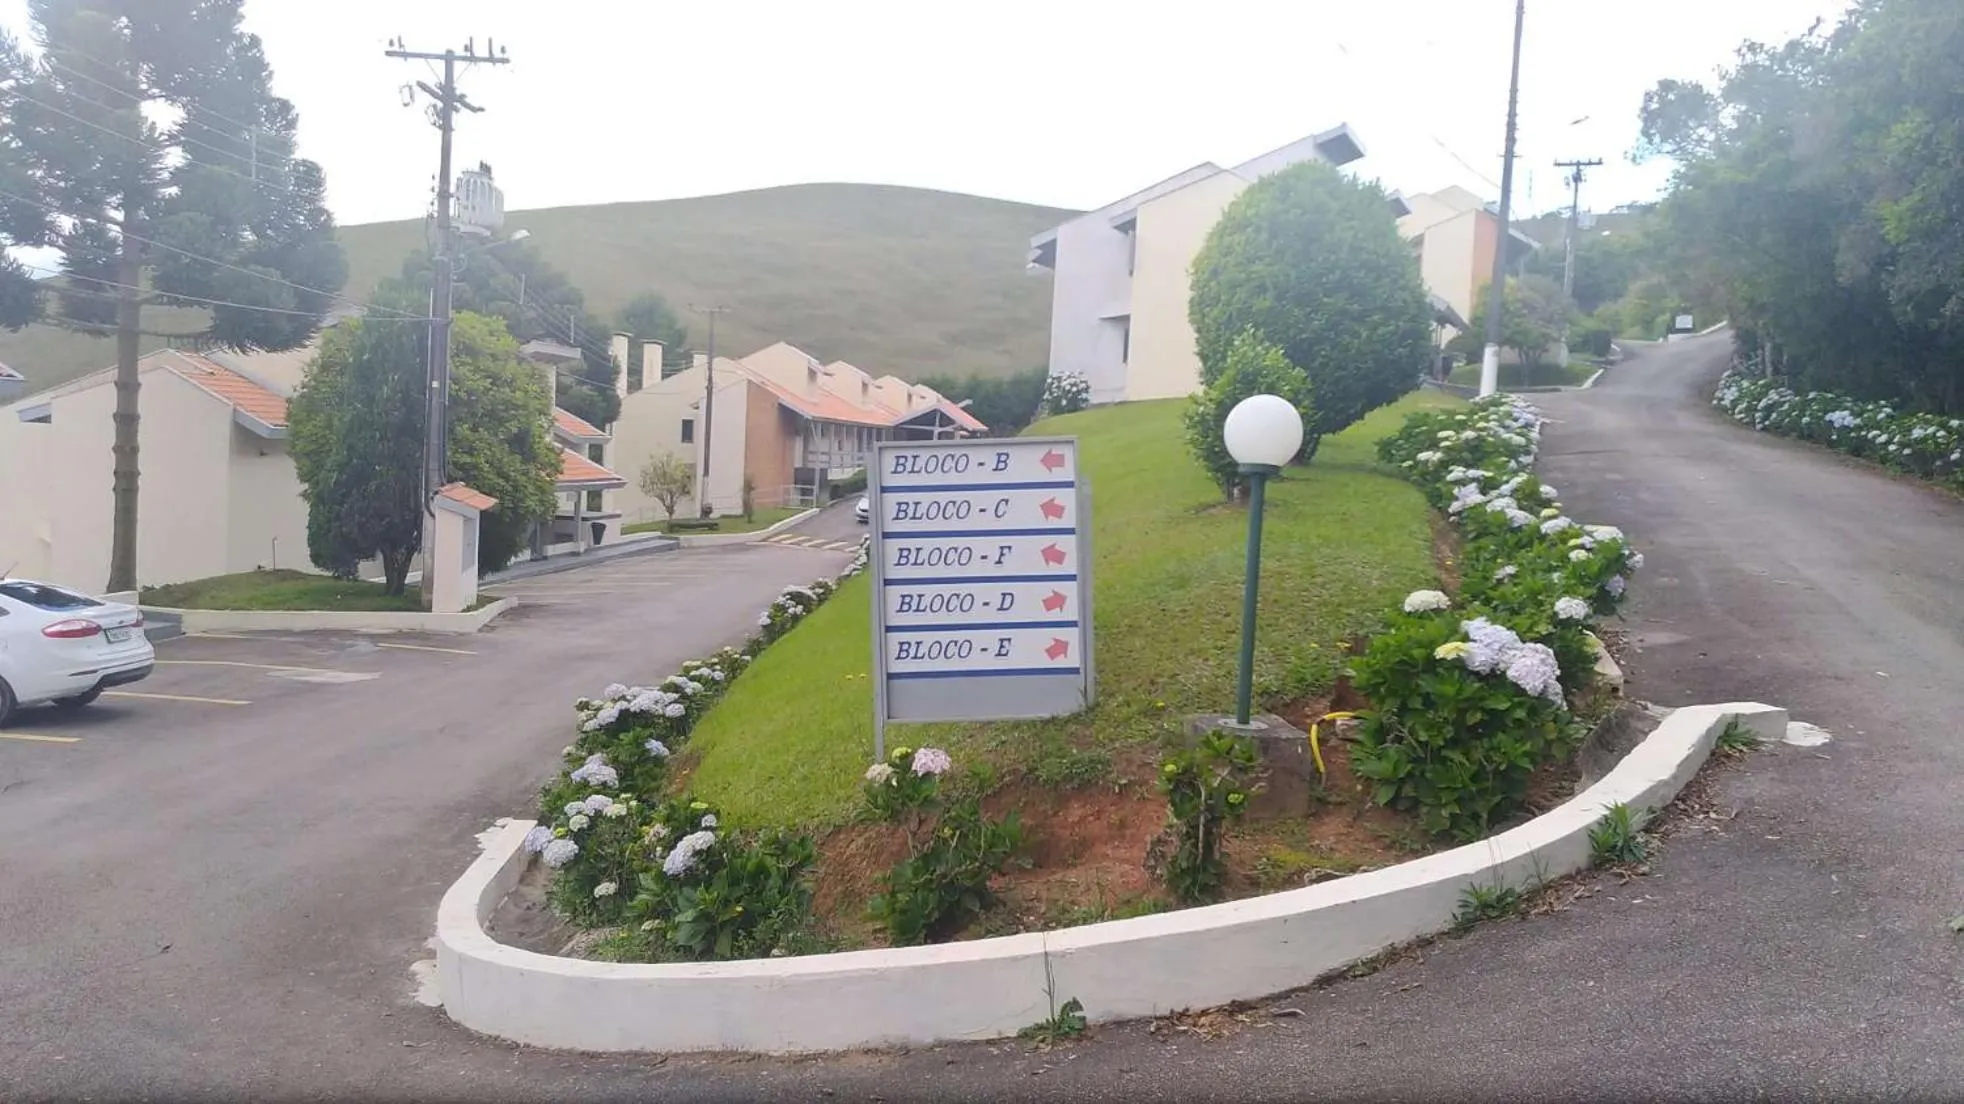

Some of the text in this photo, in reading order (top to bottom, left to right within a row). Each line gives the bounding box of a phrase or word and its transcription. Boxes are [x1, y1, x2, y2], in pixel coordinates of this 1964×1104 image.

[891, 453, 970, 474] BLOCO
[992, 452, 1010, 472] B
[892, 499, 971, 521] BLOCO
[994, 498, 1010, 519] C
[893, 546, 973, 567] BLOCO
[994, 545, 1013, 565] F
[896, 592, 975, 613] BLOCO
[996, 592, 1015, 612] D
[894, 639, 973, 661] BLOCO
[994, 637, 1012, 658] E
